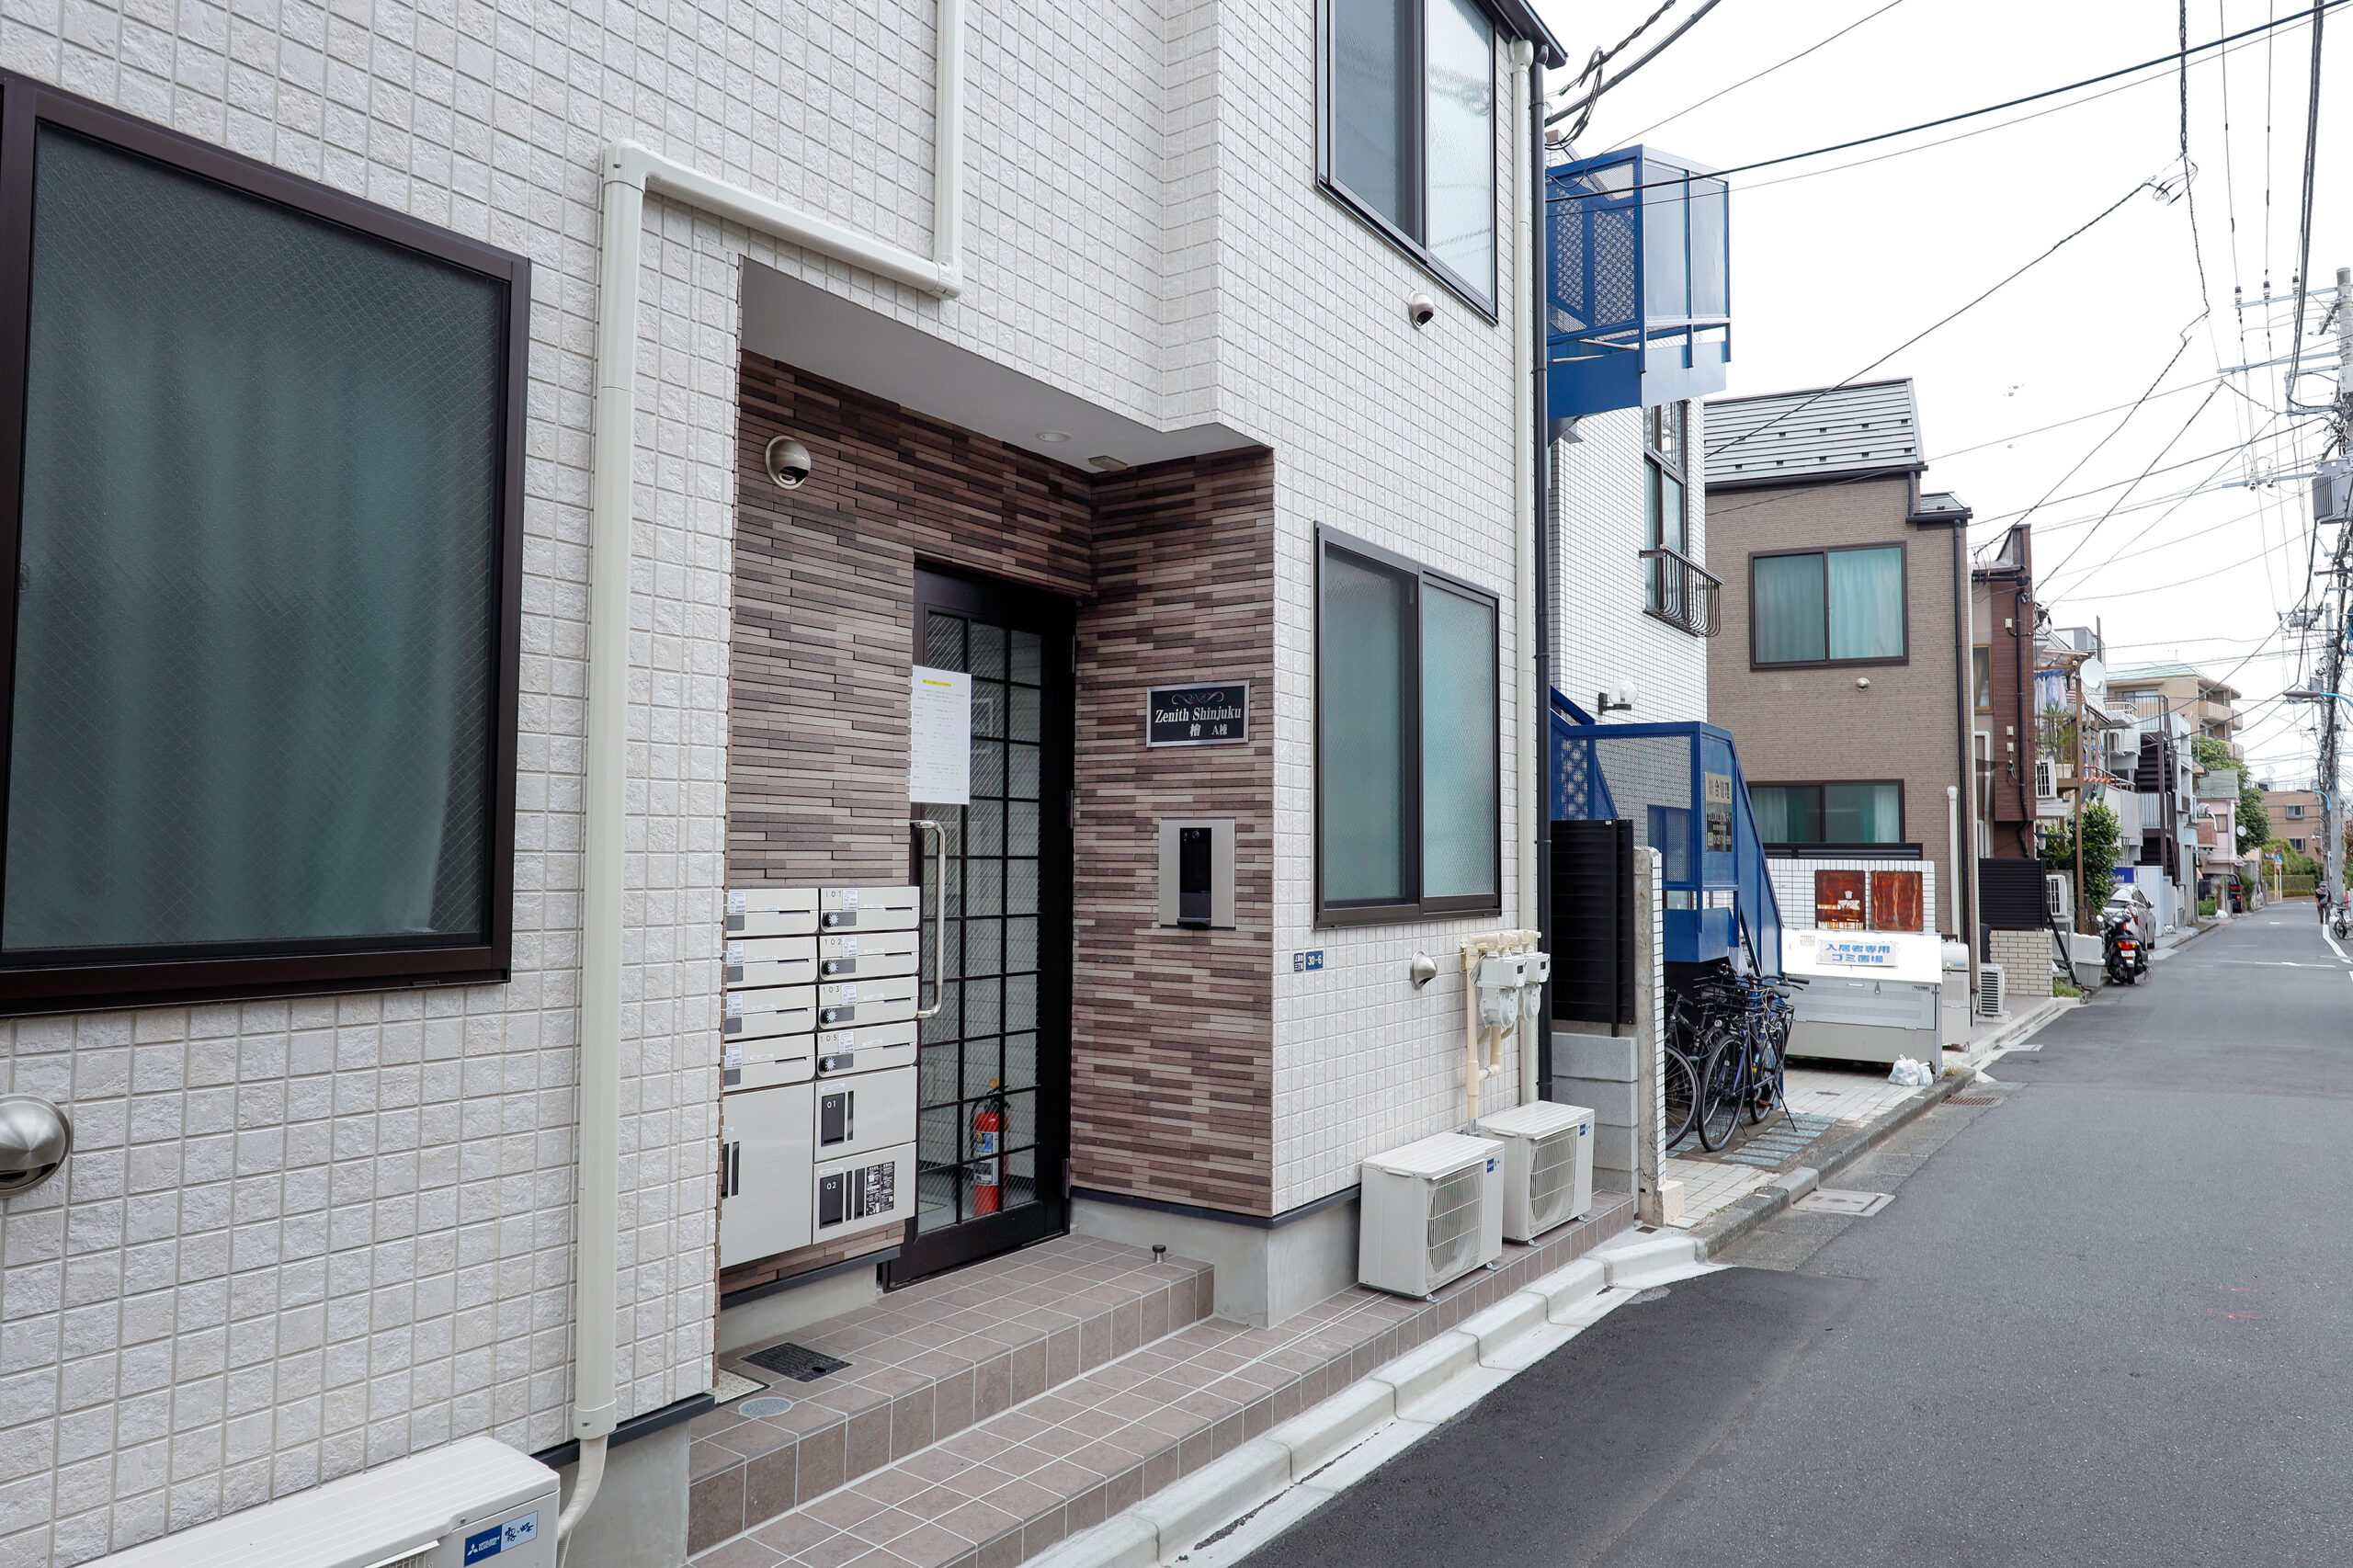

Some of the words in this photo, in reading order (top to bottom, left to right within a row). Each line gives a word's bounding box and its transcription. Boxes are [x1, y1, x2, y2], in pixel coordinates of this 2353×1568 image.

[1154, 708, 1189, 723] Zenith
[1192, 705, 1242, 722] Shinjuku
[1825, 943, 1891, 954] 入居者専用
[1307, 954, 1323, 966] 30-6
[1832, 953, 1883, 963] ゴミ置場
[820, 1034, 837, 1042] 105
[826, 1099, 836, 1108] 01
[826, 1181, 837, 1190] 02
